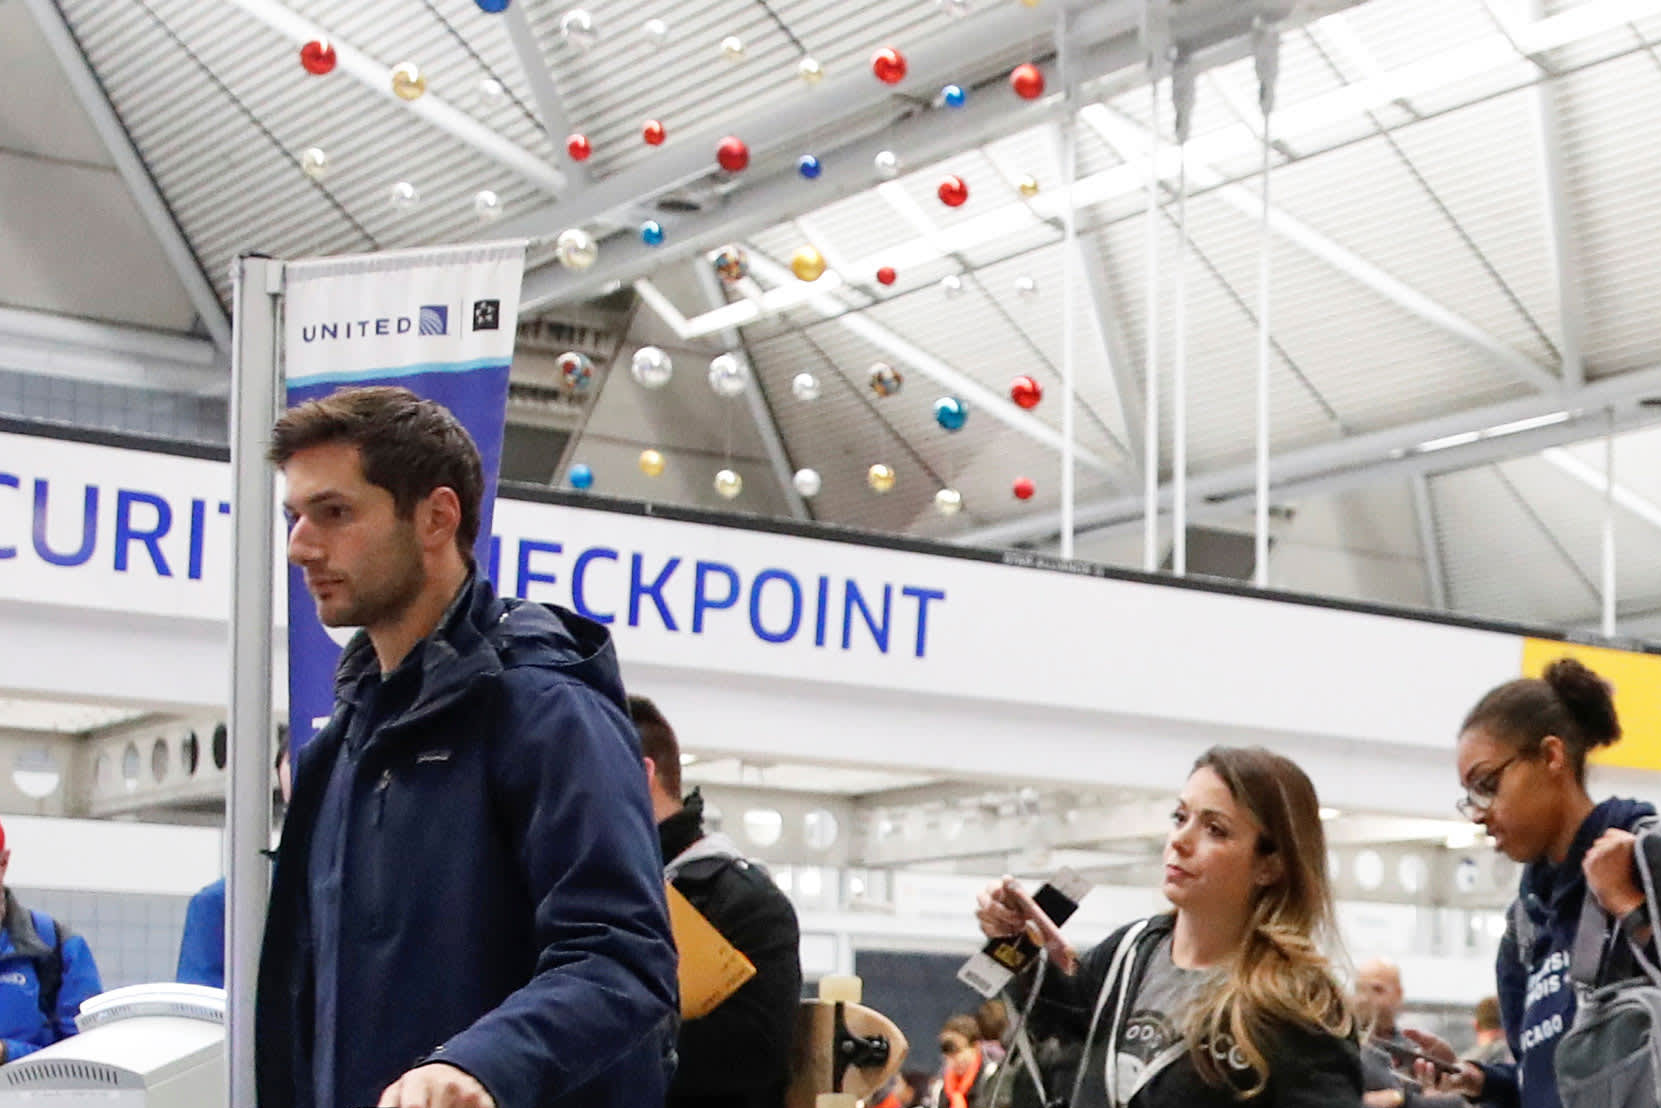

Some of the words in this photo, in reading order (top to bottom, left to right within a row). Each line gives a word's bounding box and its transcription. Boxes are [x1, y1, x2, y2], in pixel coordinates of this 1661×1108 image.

[302, 317, 412, 343] UNITED
[0, 472, 231, 581] URI
[486, 535, 947, 658] ECKPOINT
